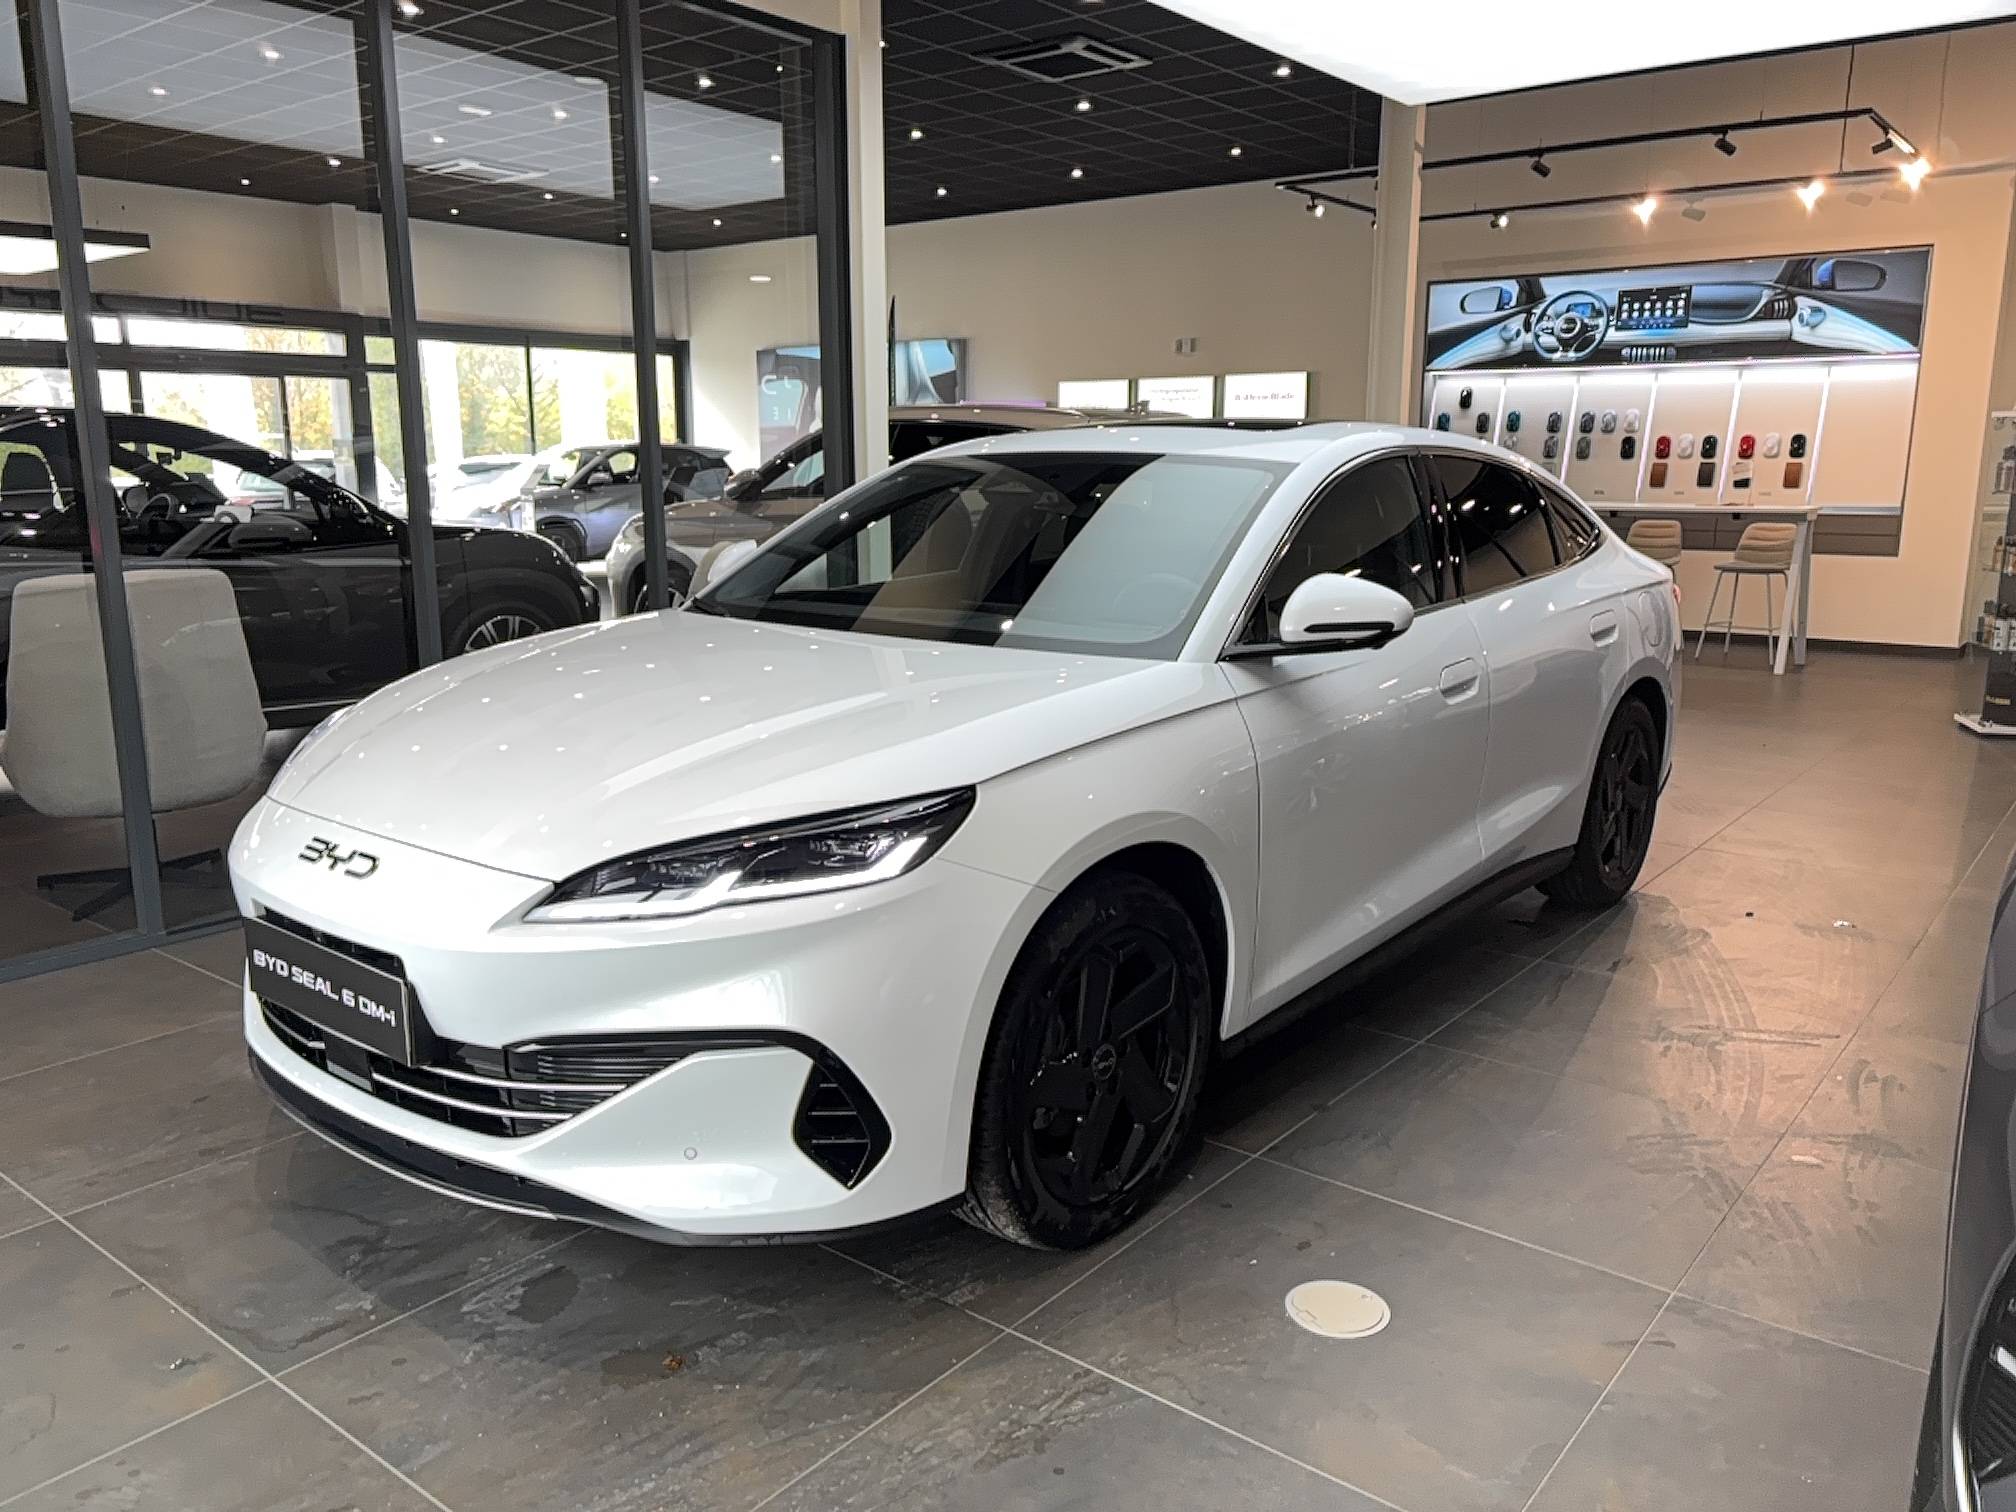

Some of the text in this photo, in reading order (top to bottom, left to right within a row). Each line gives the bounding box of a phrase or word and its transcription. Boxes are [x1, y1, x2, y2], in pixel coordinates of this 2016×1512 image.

[299, 836, 380, 880] BYD
[253, 949, 289, 978] BYD
[291, 965, 339, 1001] SEAL
[342, 988, 355, 1008] 6
